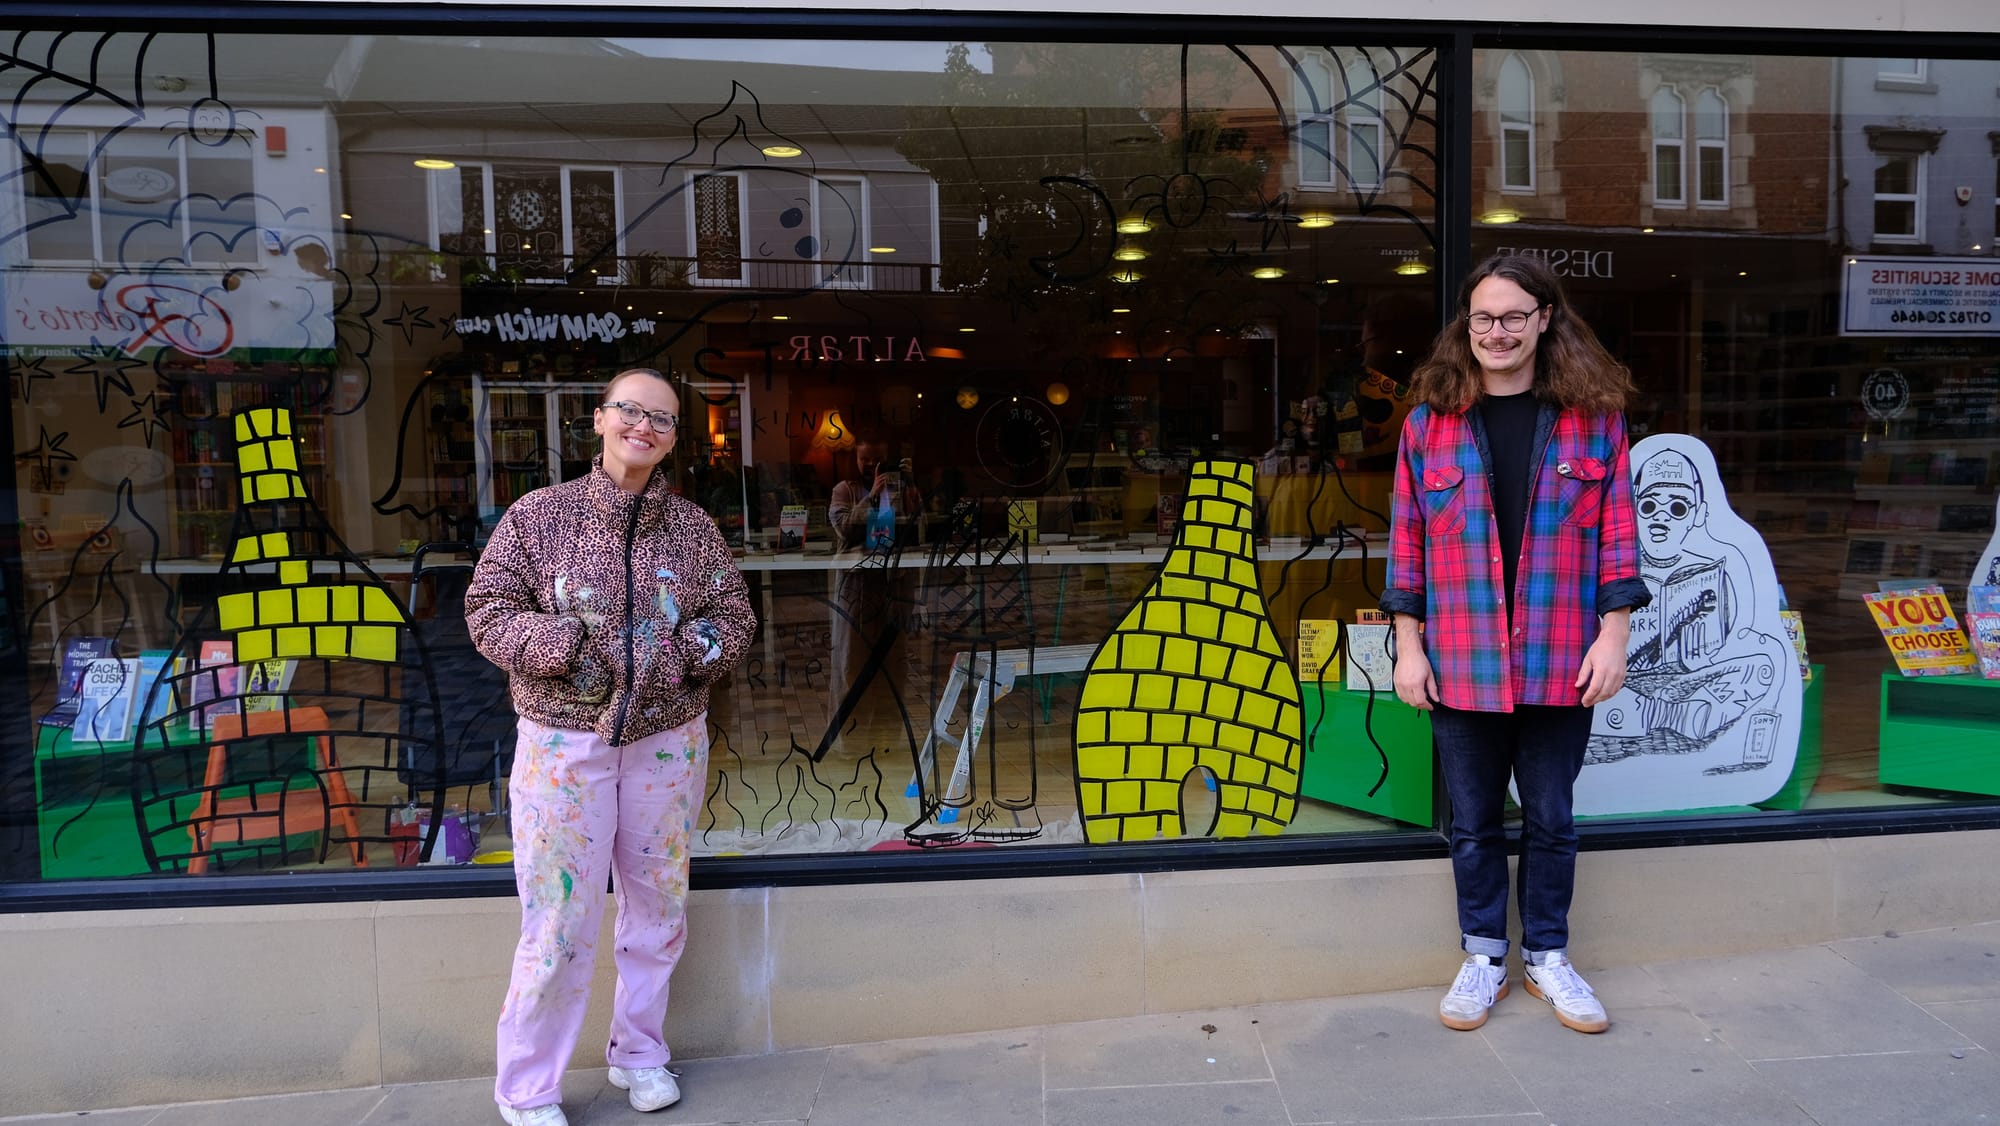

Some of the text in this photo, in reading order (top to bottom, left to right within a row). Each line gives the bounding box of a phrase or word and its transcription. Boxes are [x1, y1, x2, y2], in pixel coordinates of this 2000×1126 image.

[1872, 596, 1947, 626] YOU
[1630, 618, 1657, 632] ARK
[79, 642, 92, 650] THE
[1892, 631, 1963, 651] CHOOSE
[89, 663, 133, 674] RACHEL
[91, 674, 124, 684] CUSK
[84, 686, 108, 697] LIFE
[1753, 717, 1774, 725] SONY
